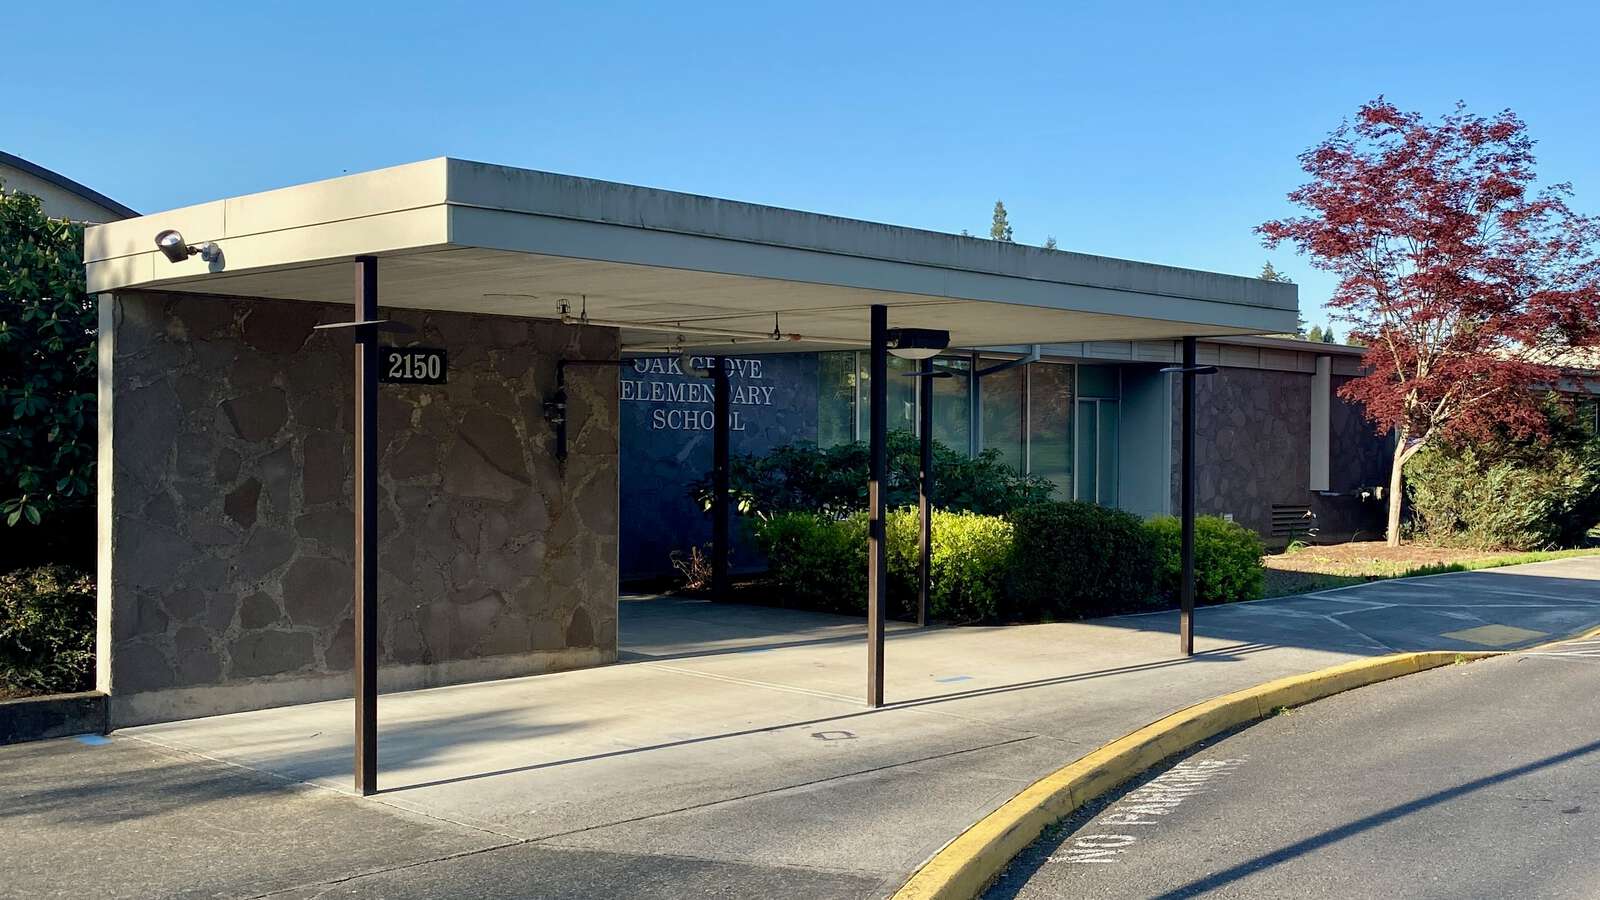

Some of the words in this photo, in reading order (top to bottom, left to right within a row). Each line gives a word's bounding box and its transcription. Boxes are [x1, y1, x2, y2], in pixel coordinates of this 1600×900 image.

[389, 353, 440, 379] 2150
[633, 357, 683, 375] OAK
[620, 380, 776, 406] ELEMENARY
[653, 409, 747, 431] SCHOL
[1045, 834, 1137, 864] NO
